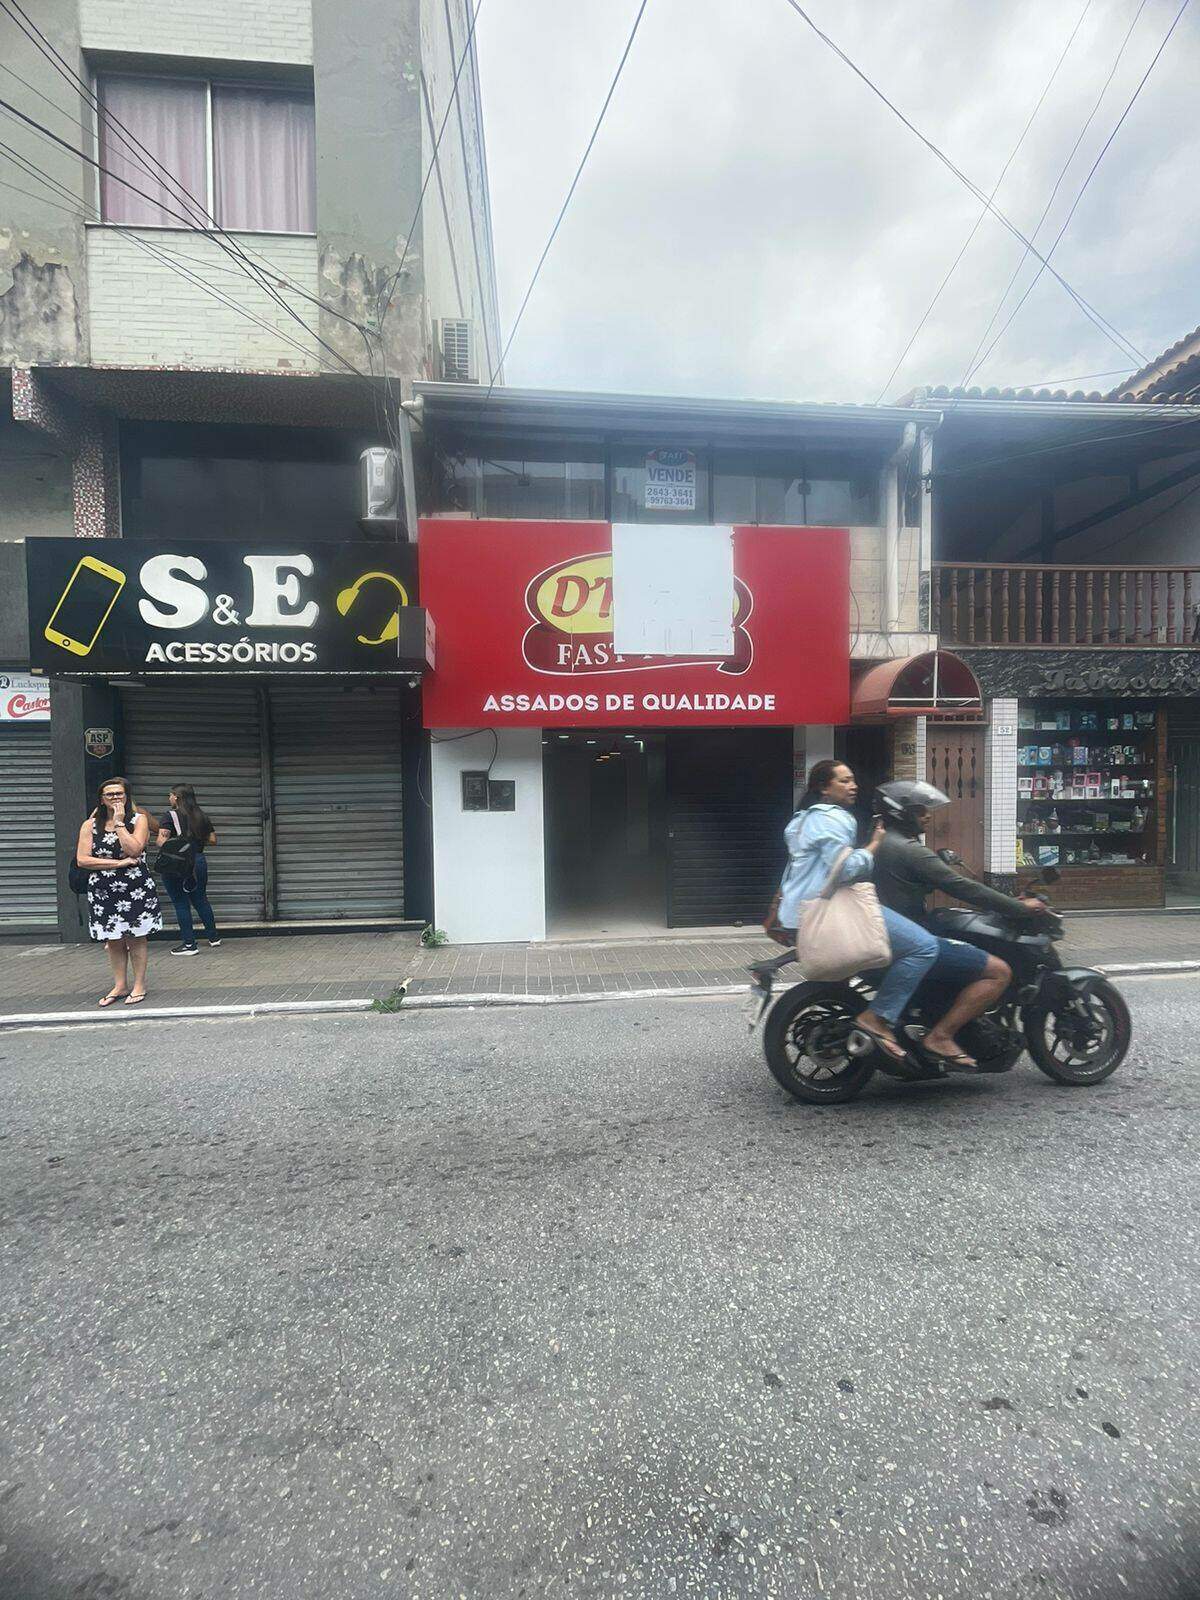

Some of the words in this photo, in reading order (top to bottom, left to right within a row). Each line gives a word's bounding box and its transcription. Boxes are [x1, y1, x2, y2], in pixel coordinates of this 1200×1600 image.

[648, 468, 694, 483] VENDE
[145, 636, 318, 663] ACESSÓRIOS
[11, 680, 50, 690] Luckspu
[483, 694, 600, 711] ASSADOS
[605, 694, 635, 711] DE
[642, 694, 776, 711] QUALIDADE
[91, 733, 109, 743] ASP
